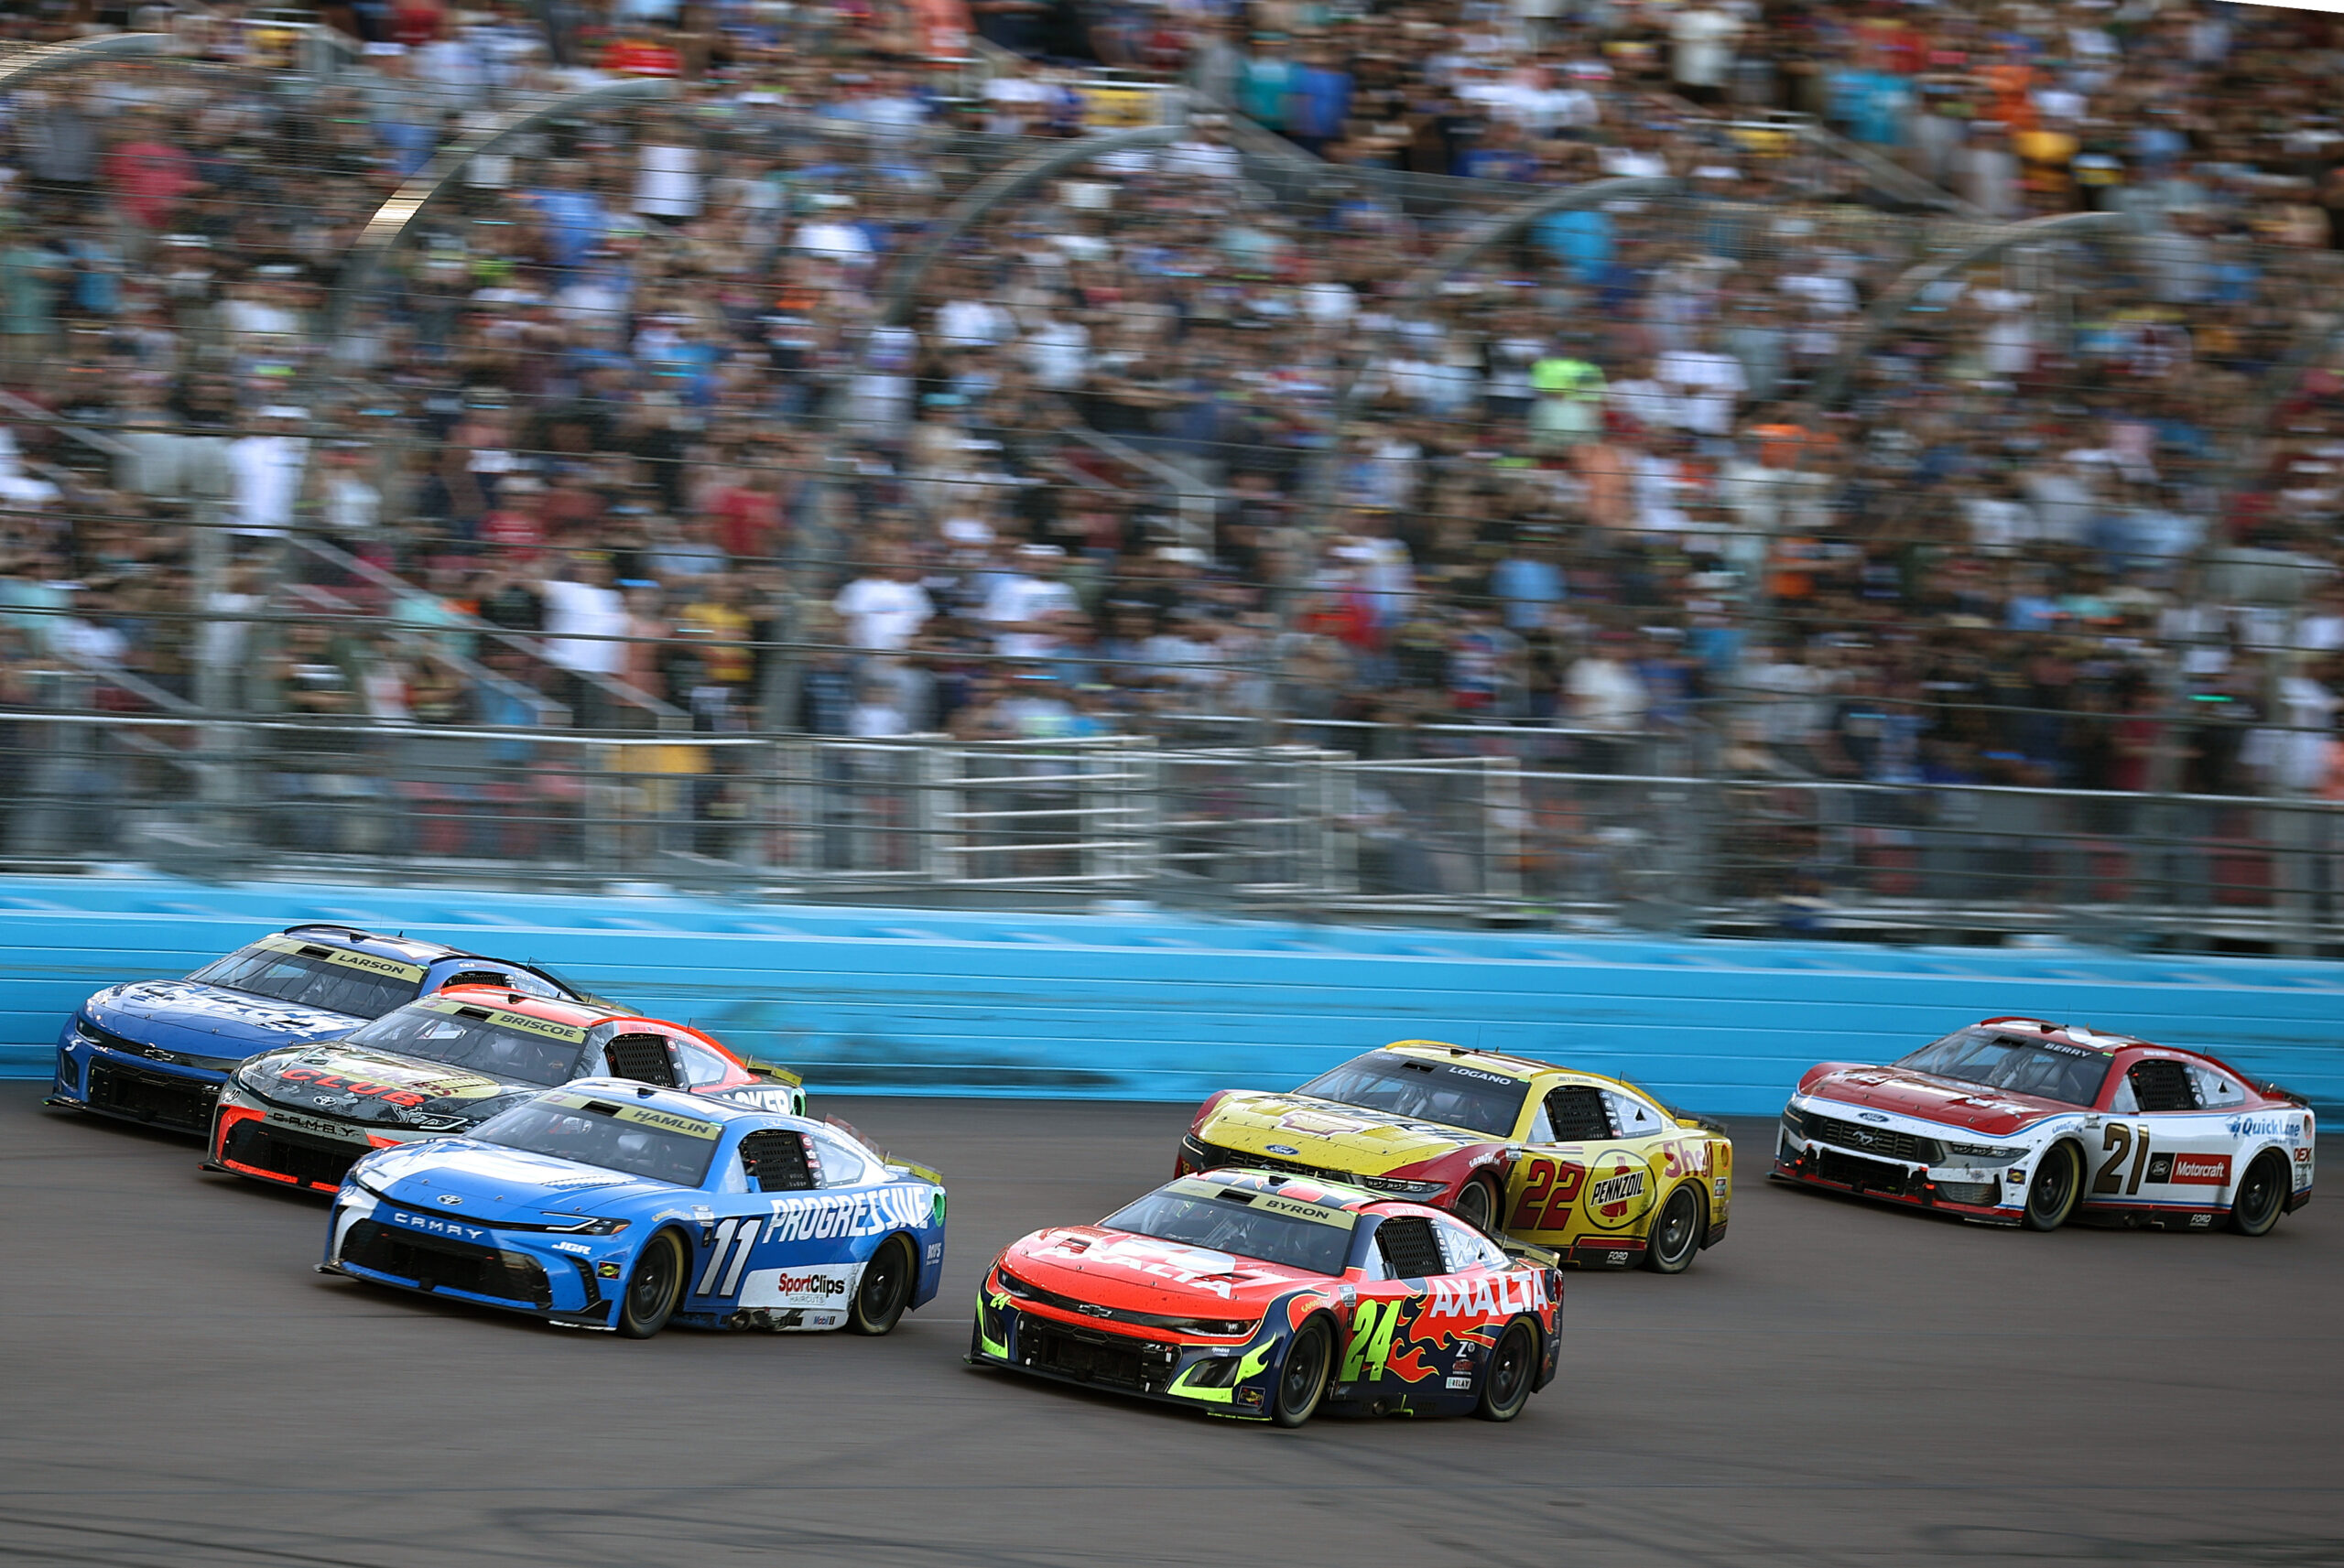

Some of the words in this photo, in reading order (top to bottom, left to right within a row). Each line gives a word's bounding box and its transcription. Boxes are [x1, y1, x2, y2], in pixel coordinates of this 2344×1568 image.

[338, 954, 405, 975] LARSON
[499, 1014, 577, 1038] BRISCOE
[2043, 1042, 2091, 1058] BERRY
[281, 1068, 426, 1106] CLUB
[1449, 1066, 1511, 1087] LOGANO
[273, 1112, 359, 1137] CAMRY
[634, 1110, 710, 1134] HAMLIN
[1267, 1144, 1296, 1155] Ford
[2093, 1122, 2149, 1195] 21
[2176, 1161, 2224, 1178] Motorcraft
[1508, 1159, 1586, 1230] 22
[1590, 1171, 1644, 1207] PENNZOIL
[762, 1186, 928, 1244] PROGRESSIVE
[1265, 1200, 1329, 1219] BYRON
[2191, 1214, 2212, 1222] FORD
[393, 1212, 484, 1239] CAMRY
[551, 1241, 592, 1255] JGR
[695, 1217, 761, 1298] 11
[1608, 1250, 1629, 1260] FORD
[778, 1272, 844, 1297] SportClips
[1030, 1247, 1232, 1299] AXALTA
[789, 1295, 824, 1303] HAIRCUTS
[990, 1292, 1012, 1310] 24
[1429, 1270, 1548, 1318] AXALTA
[813, 1315, 829, 1325] Mobil
[1339, 1299, 1402, 1382] 24
